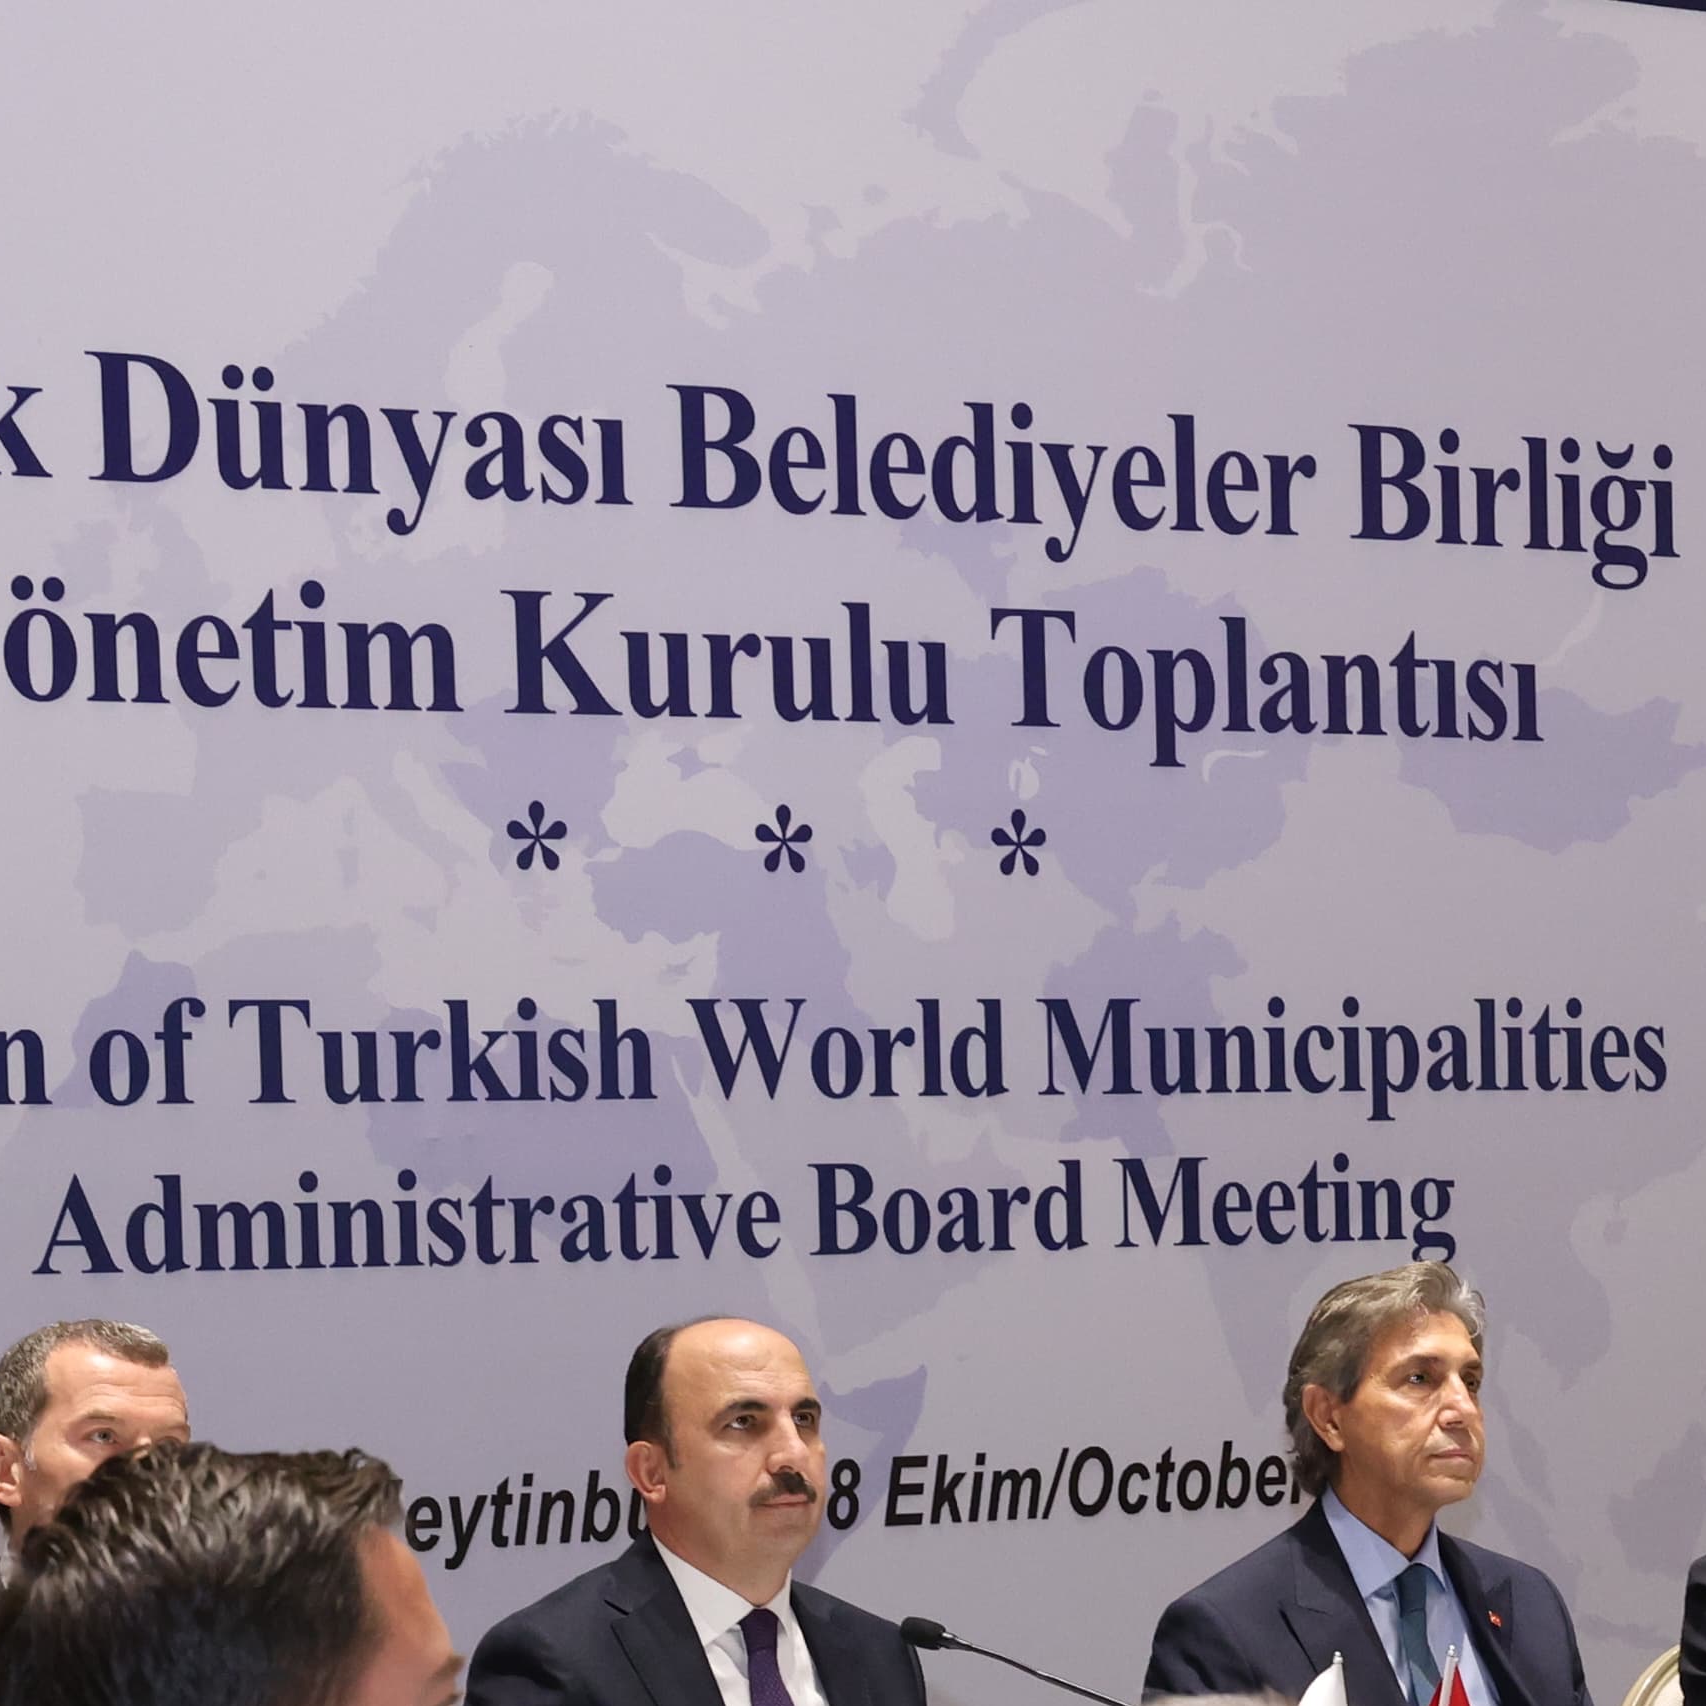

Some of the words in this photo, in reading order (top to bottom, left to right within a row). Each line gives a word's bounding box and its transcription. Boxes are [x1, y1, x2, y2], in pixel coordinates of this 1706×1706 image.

[84, 350, 634, 537] Dünyası
[665, 384, 1317, 563] Belediyeler
[1347, 423, 1681, 591] Birliği
[500, 588, 954, 725] Kurulu
[990, 606, 1544, 768] Toplantısı
[89, 996, 207, 1108] of
[228, 997, 657, 1107] Turkish
[685, 997, 1010, 1099] World
[1036, 996, 1668, 1122] Municipalities
[31, 1163, 781, 1276] Administrative
[806, 1159, 1088, 1258] Board
[1112, 1152, 1456, 1264] Meeting
[405, 1470, 648, 1570] eytinb
